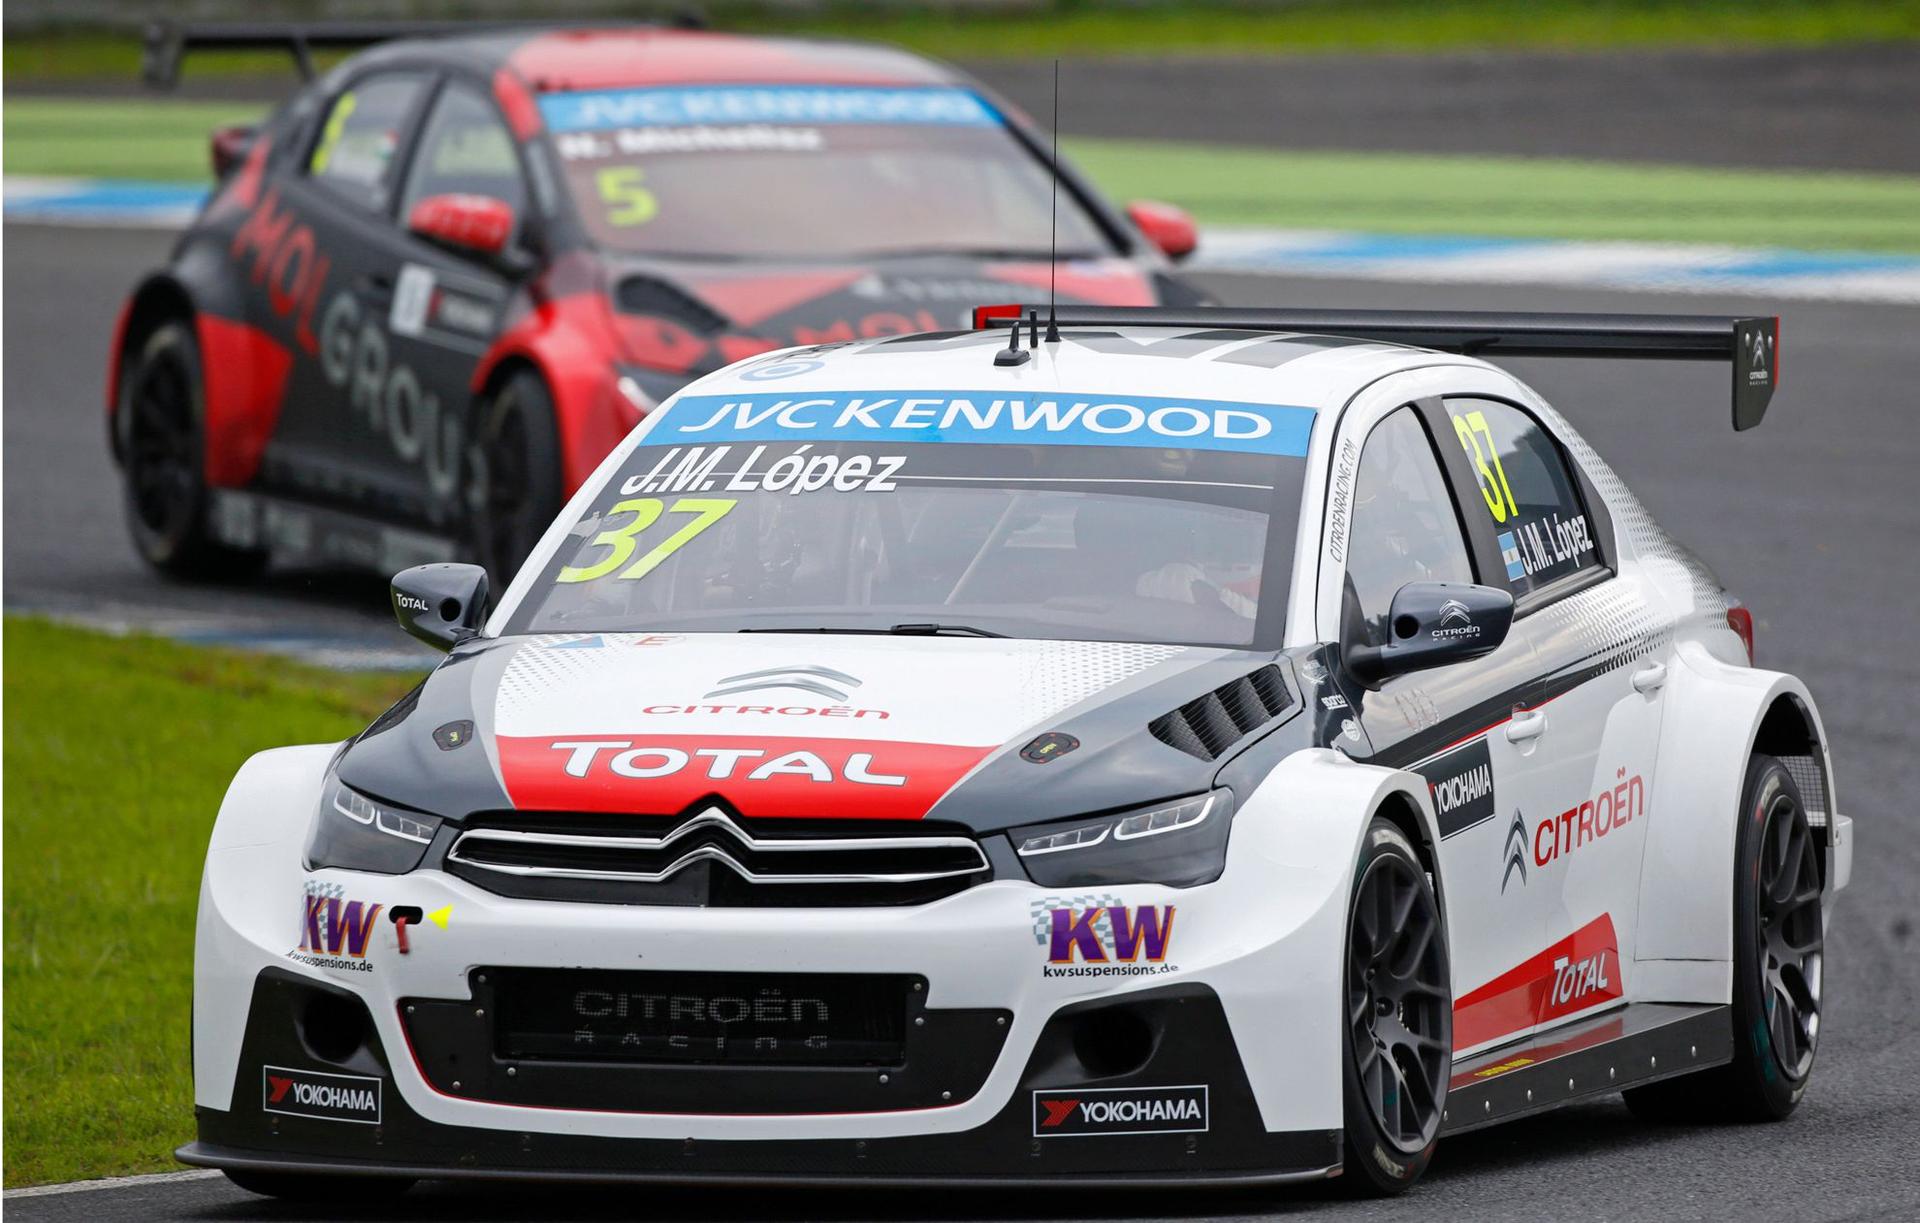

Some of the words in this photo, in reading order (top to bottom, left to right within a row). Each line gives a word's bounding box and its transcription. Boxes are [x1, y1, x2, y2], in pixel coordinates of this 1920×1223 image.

[597, 165, 661, 227] 5
[231, 186, 332, 359] MOL
[620, 446, 732, 495] J.M.
[724, 443, 907, 496] López
[1453, 410, 1519, 523] 37
[1330, 438, 1358, 563] CITROENRACING.COM
[555, 498, 739, 584] 37
[1516, 521, 1554, 576] J.M.
[1542, 512, 1594, 569] López
[396, 593, 429, 611] TOTAL
[1431, 625, 1481, 637] CITROËN
[642, 704, 891, 720] CITROËN
[550, 741, 908, 787] TOTAL
[1434, 763, 1492, 816] YOKOHAMA
[1534, 766, 1644, 868] CITROËN
[298, 894, 385, 958] KW
[1048, 904, 1177, 964] KW
[286, 949, 374, 972] kwsuspensions.de
[1043, 963, 1180, 978] kwsuspensions.de
[1551, 952, 1608, 1008] TOTAL
[574, 988, 830, 1023] CITROËN
[292, 1081, 377, 1112] YOKOHAMA
[1079, 1098, 1202, 1123] YOKOHAMA
